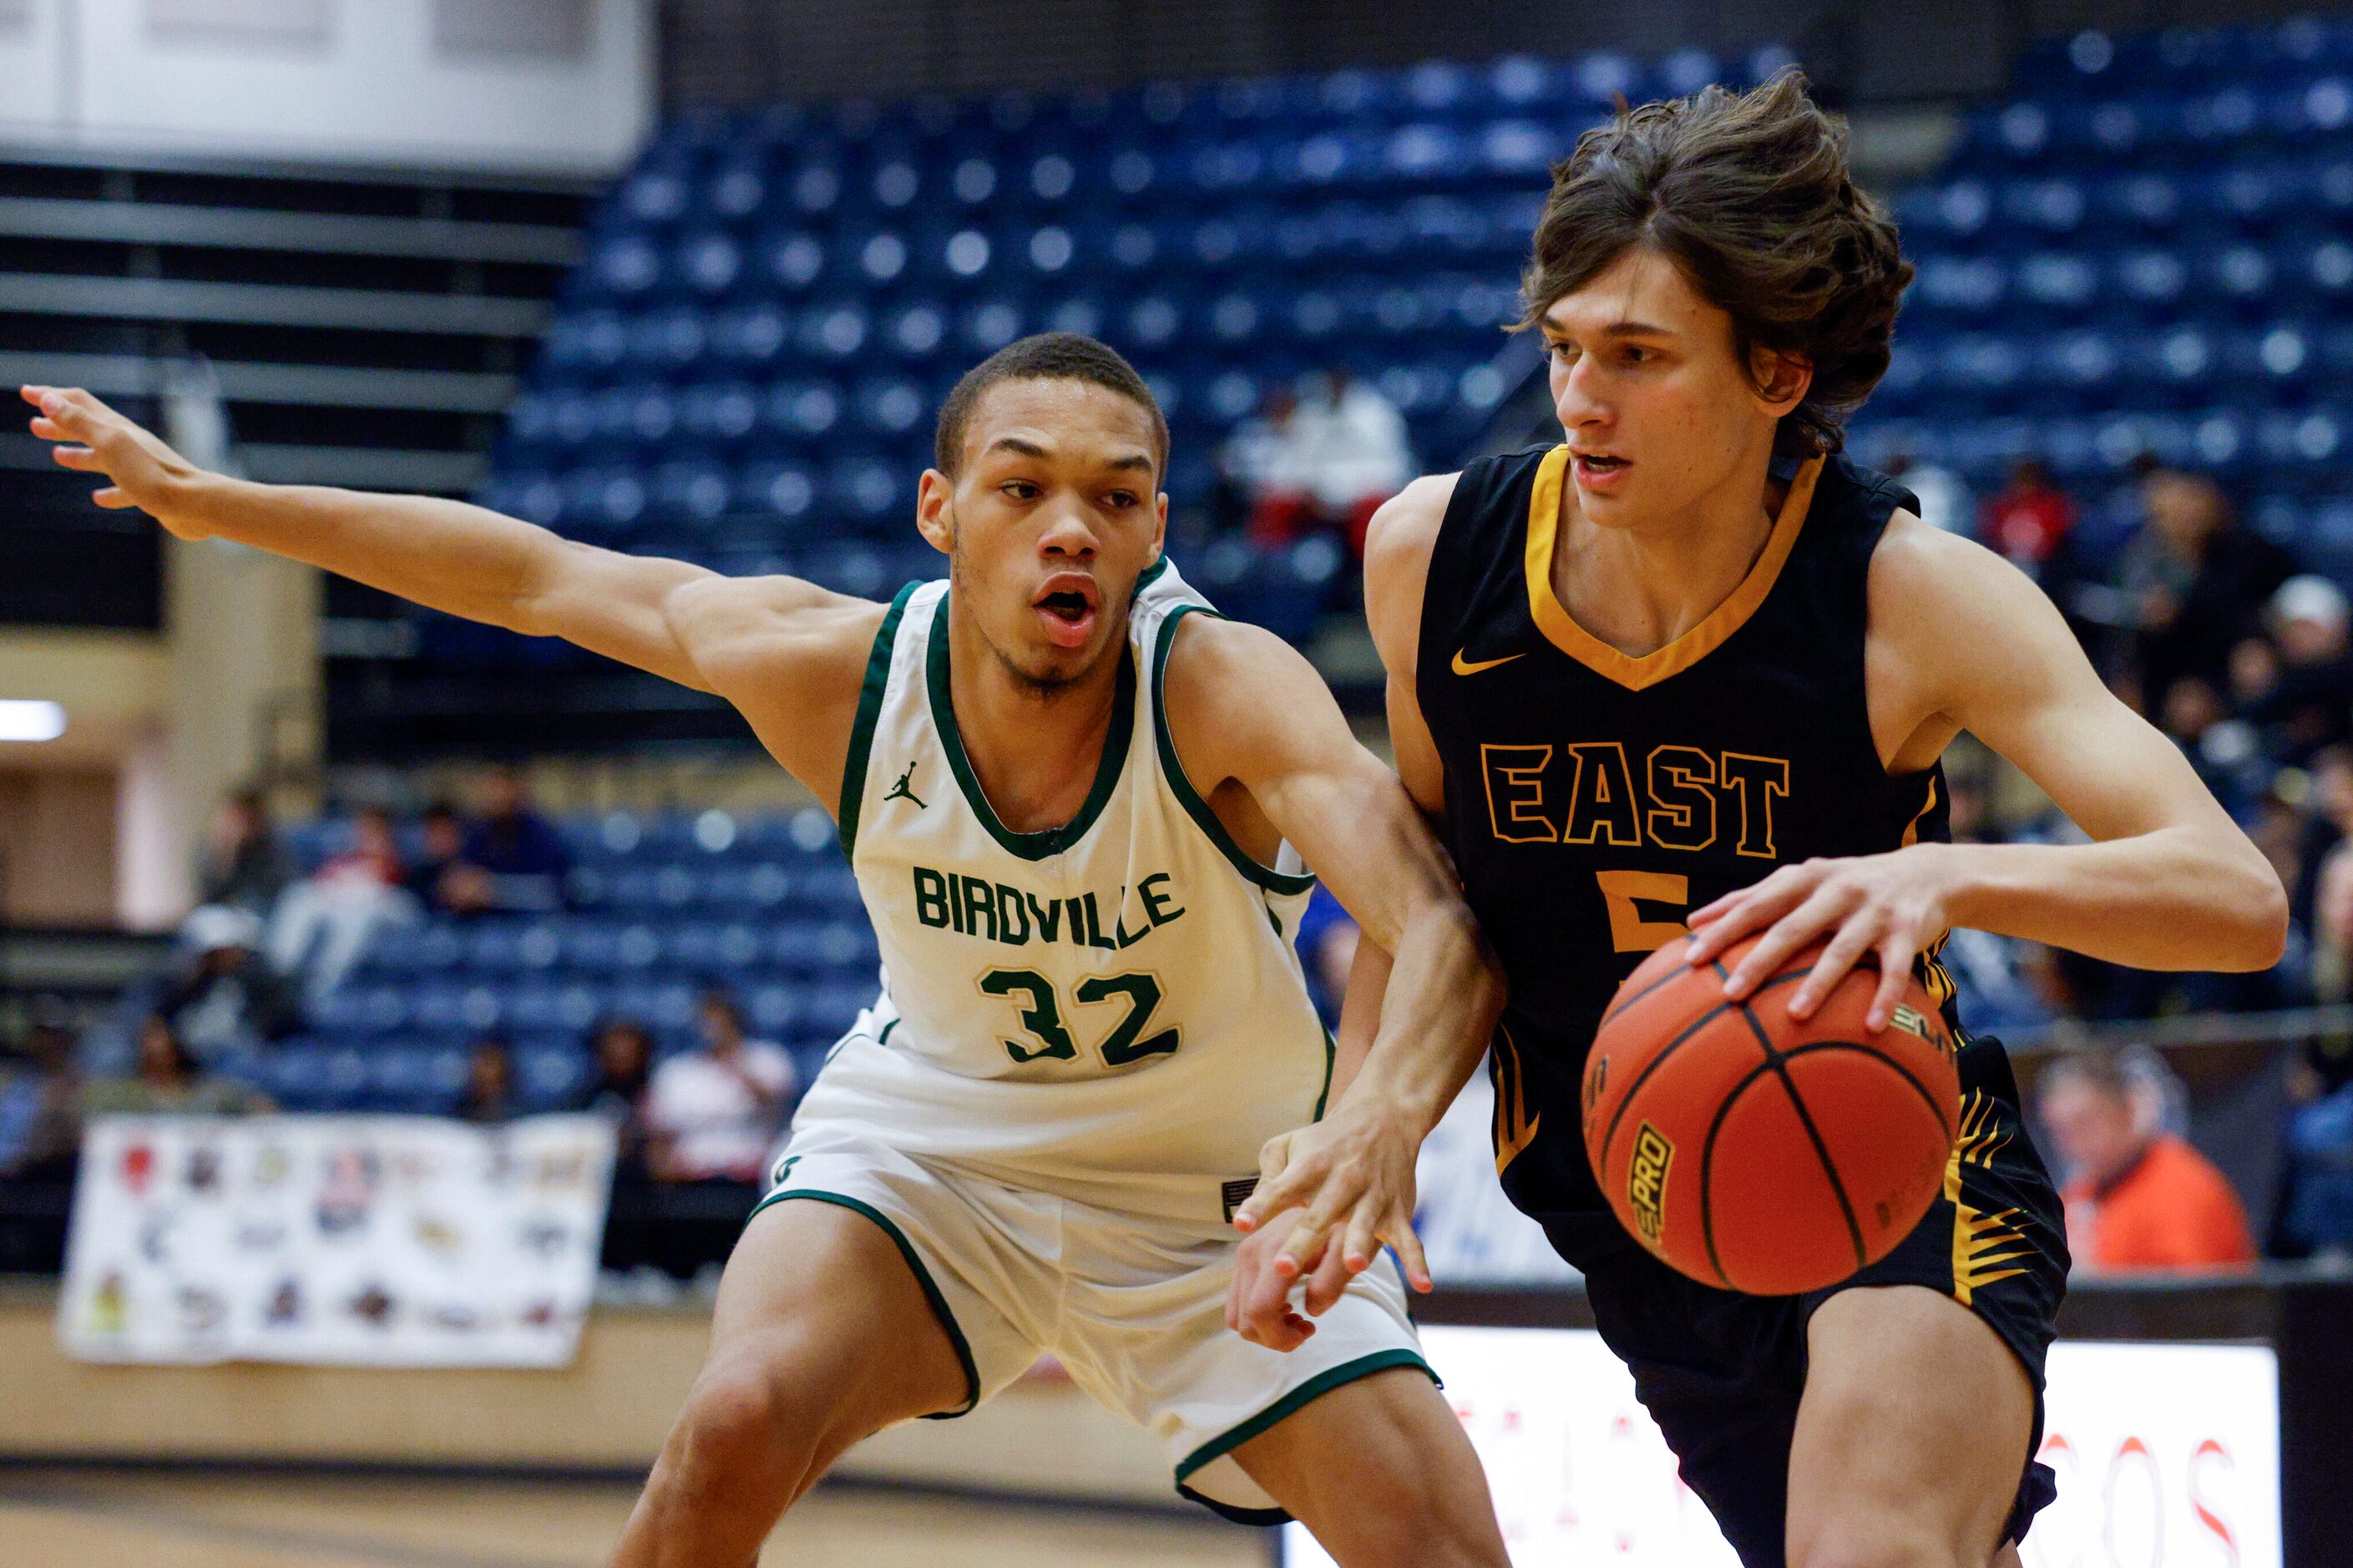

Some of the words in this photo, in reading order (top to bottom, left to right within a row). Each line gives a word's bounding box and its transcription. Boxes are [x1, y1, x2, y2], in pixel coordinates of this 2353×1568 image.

[1480, 741, 1789, 859] EAST
[913, 866, 1186, 950] BIRDVILLE
[975, 965, 1183, 1070] 32
